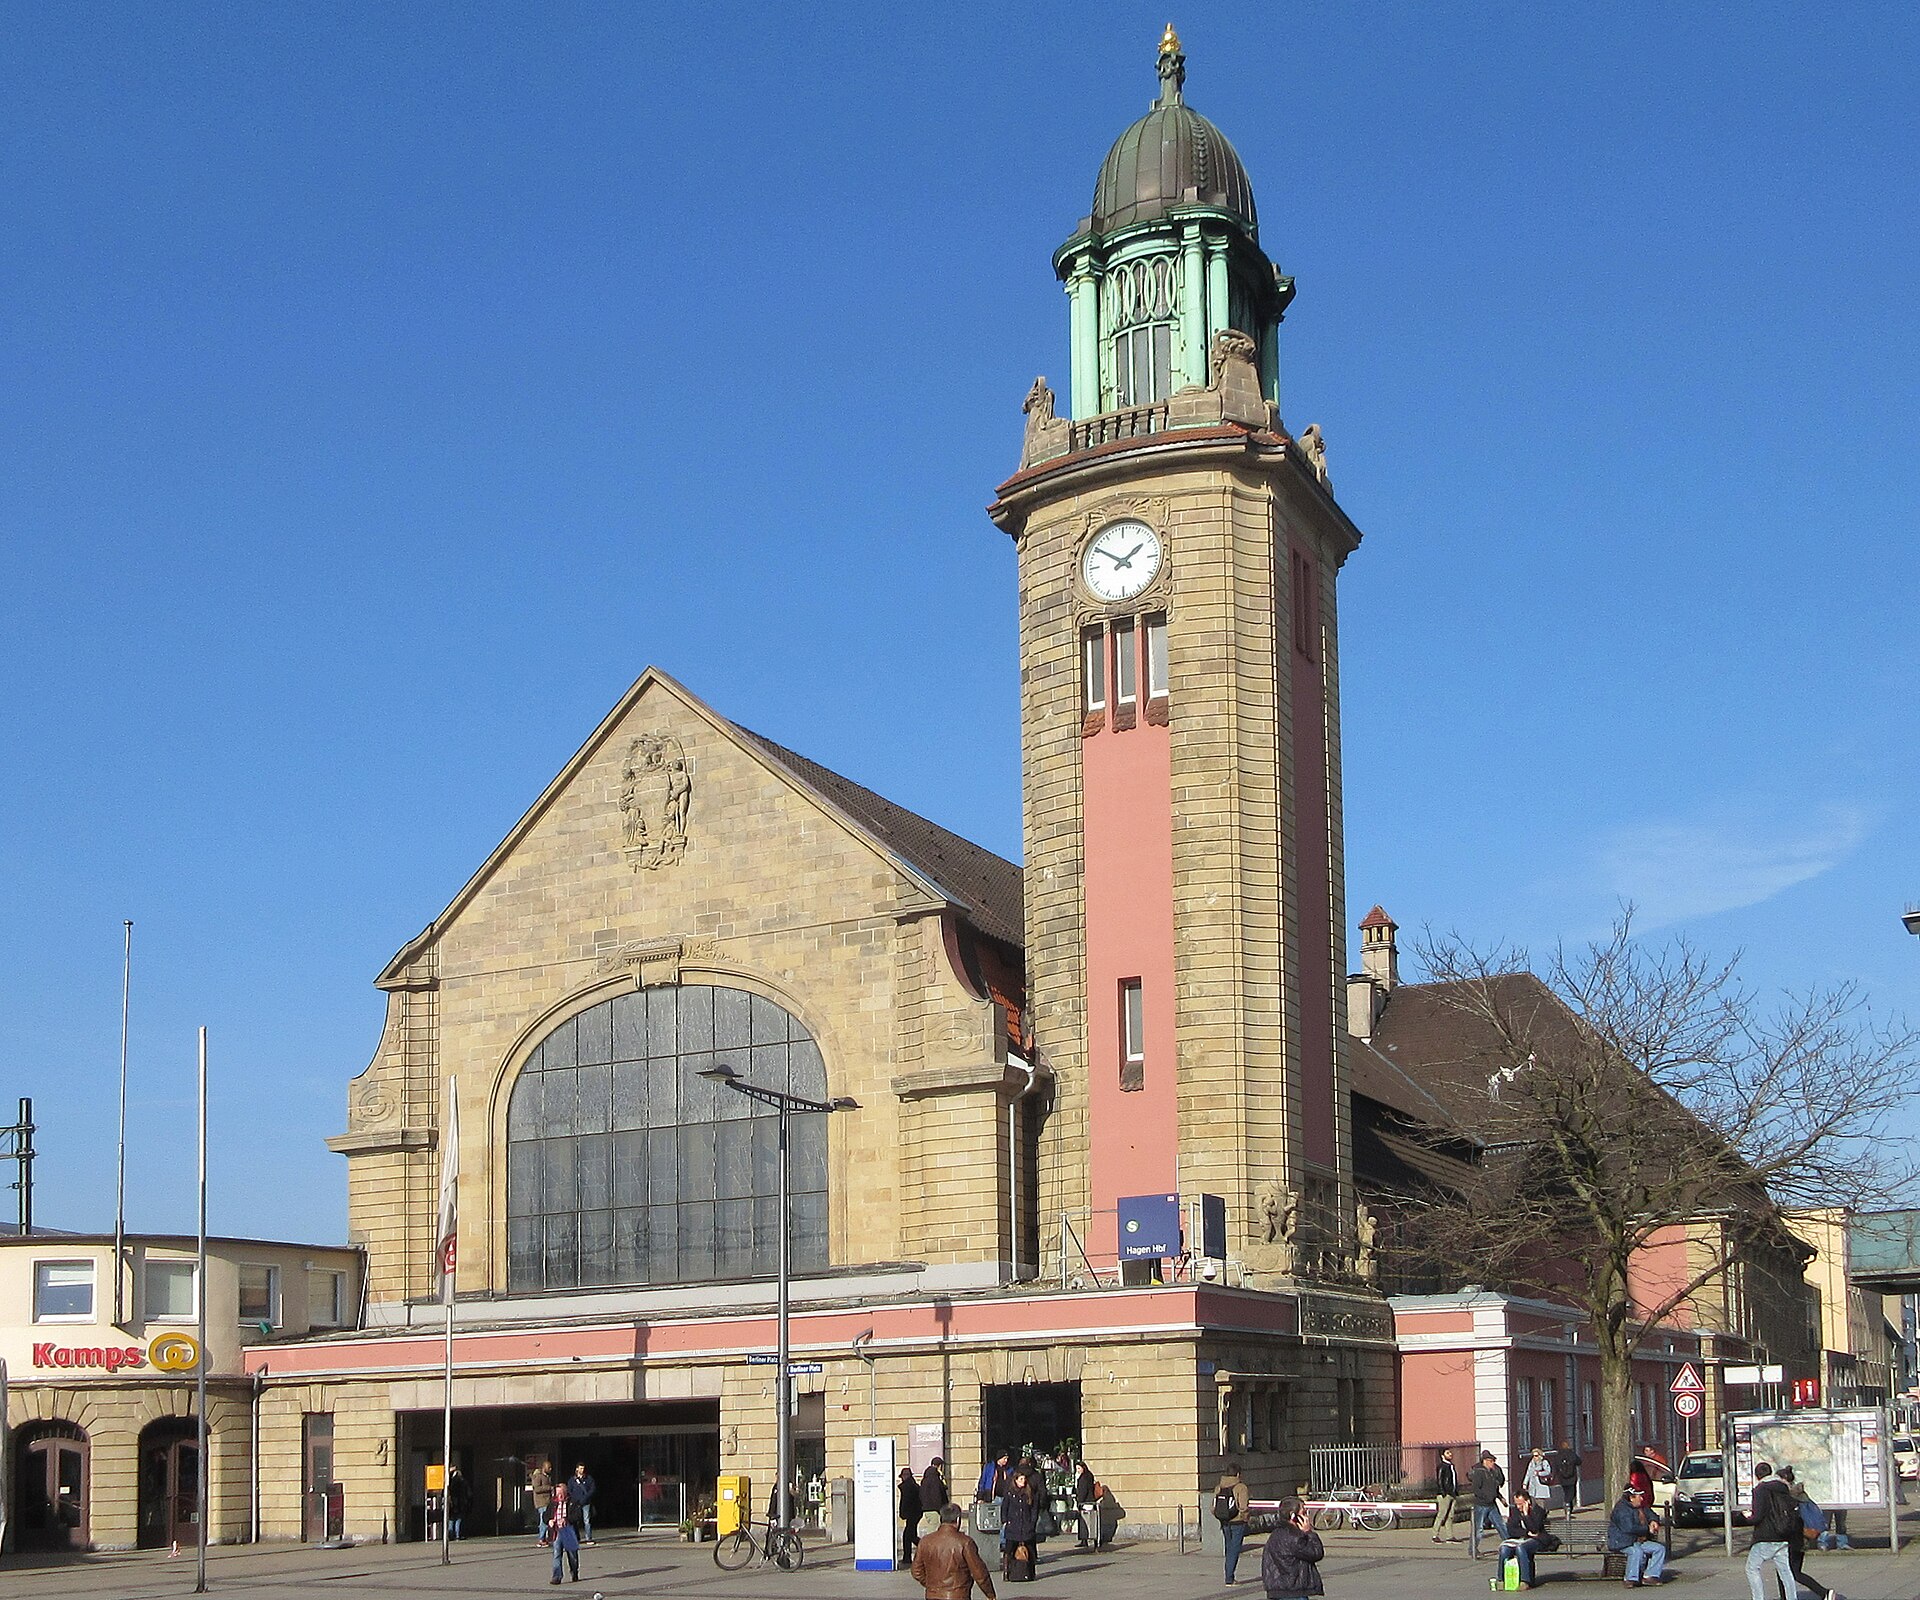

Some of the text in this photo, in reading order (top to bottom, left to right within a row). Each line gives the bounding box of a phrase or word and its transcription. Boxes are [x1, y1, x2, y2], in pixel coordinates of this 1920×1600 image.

[1126, 1220, 1139, 1233] S
[1126, 1244, 1167, 1256] Hagen Hbf
[32, 1343, 141, 1372] Kamps
[749, 1355, 778, 1363] Berliner Platz
[790, 1365, 808, 1373] Berliner
[1680, 1399, 1695, 1410] 30
